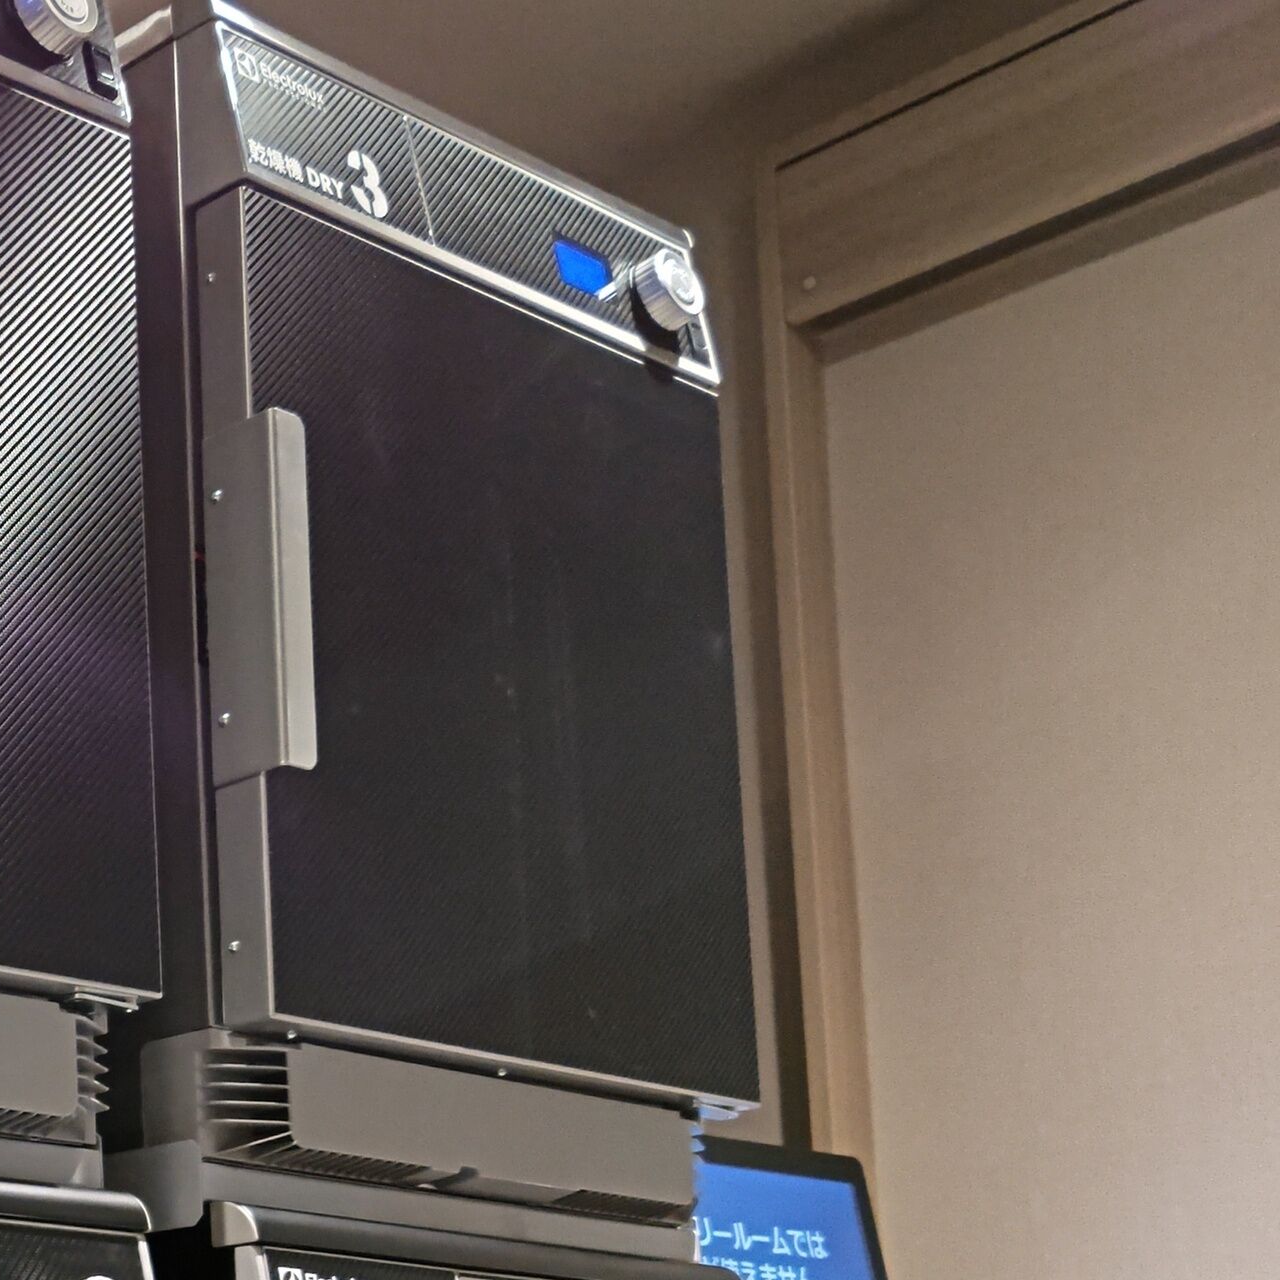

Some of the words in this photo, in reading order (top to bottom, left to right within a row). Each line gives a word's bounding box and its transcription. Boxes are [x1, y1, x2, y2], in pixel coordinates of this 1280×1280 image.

[259, 62, 325, 105] Electrolux
[306, 166, 344, 199] DRY
[347, 150, 388, 218] 3
